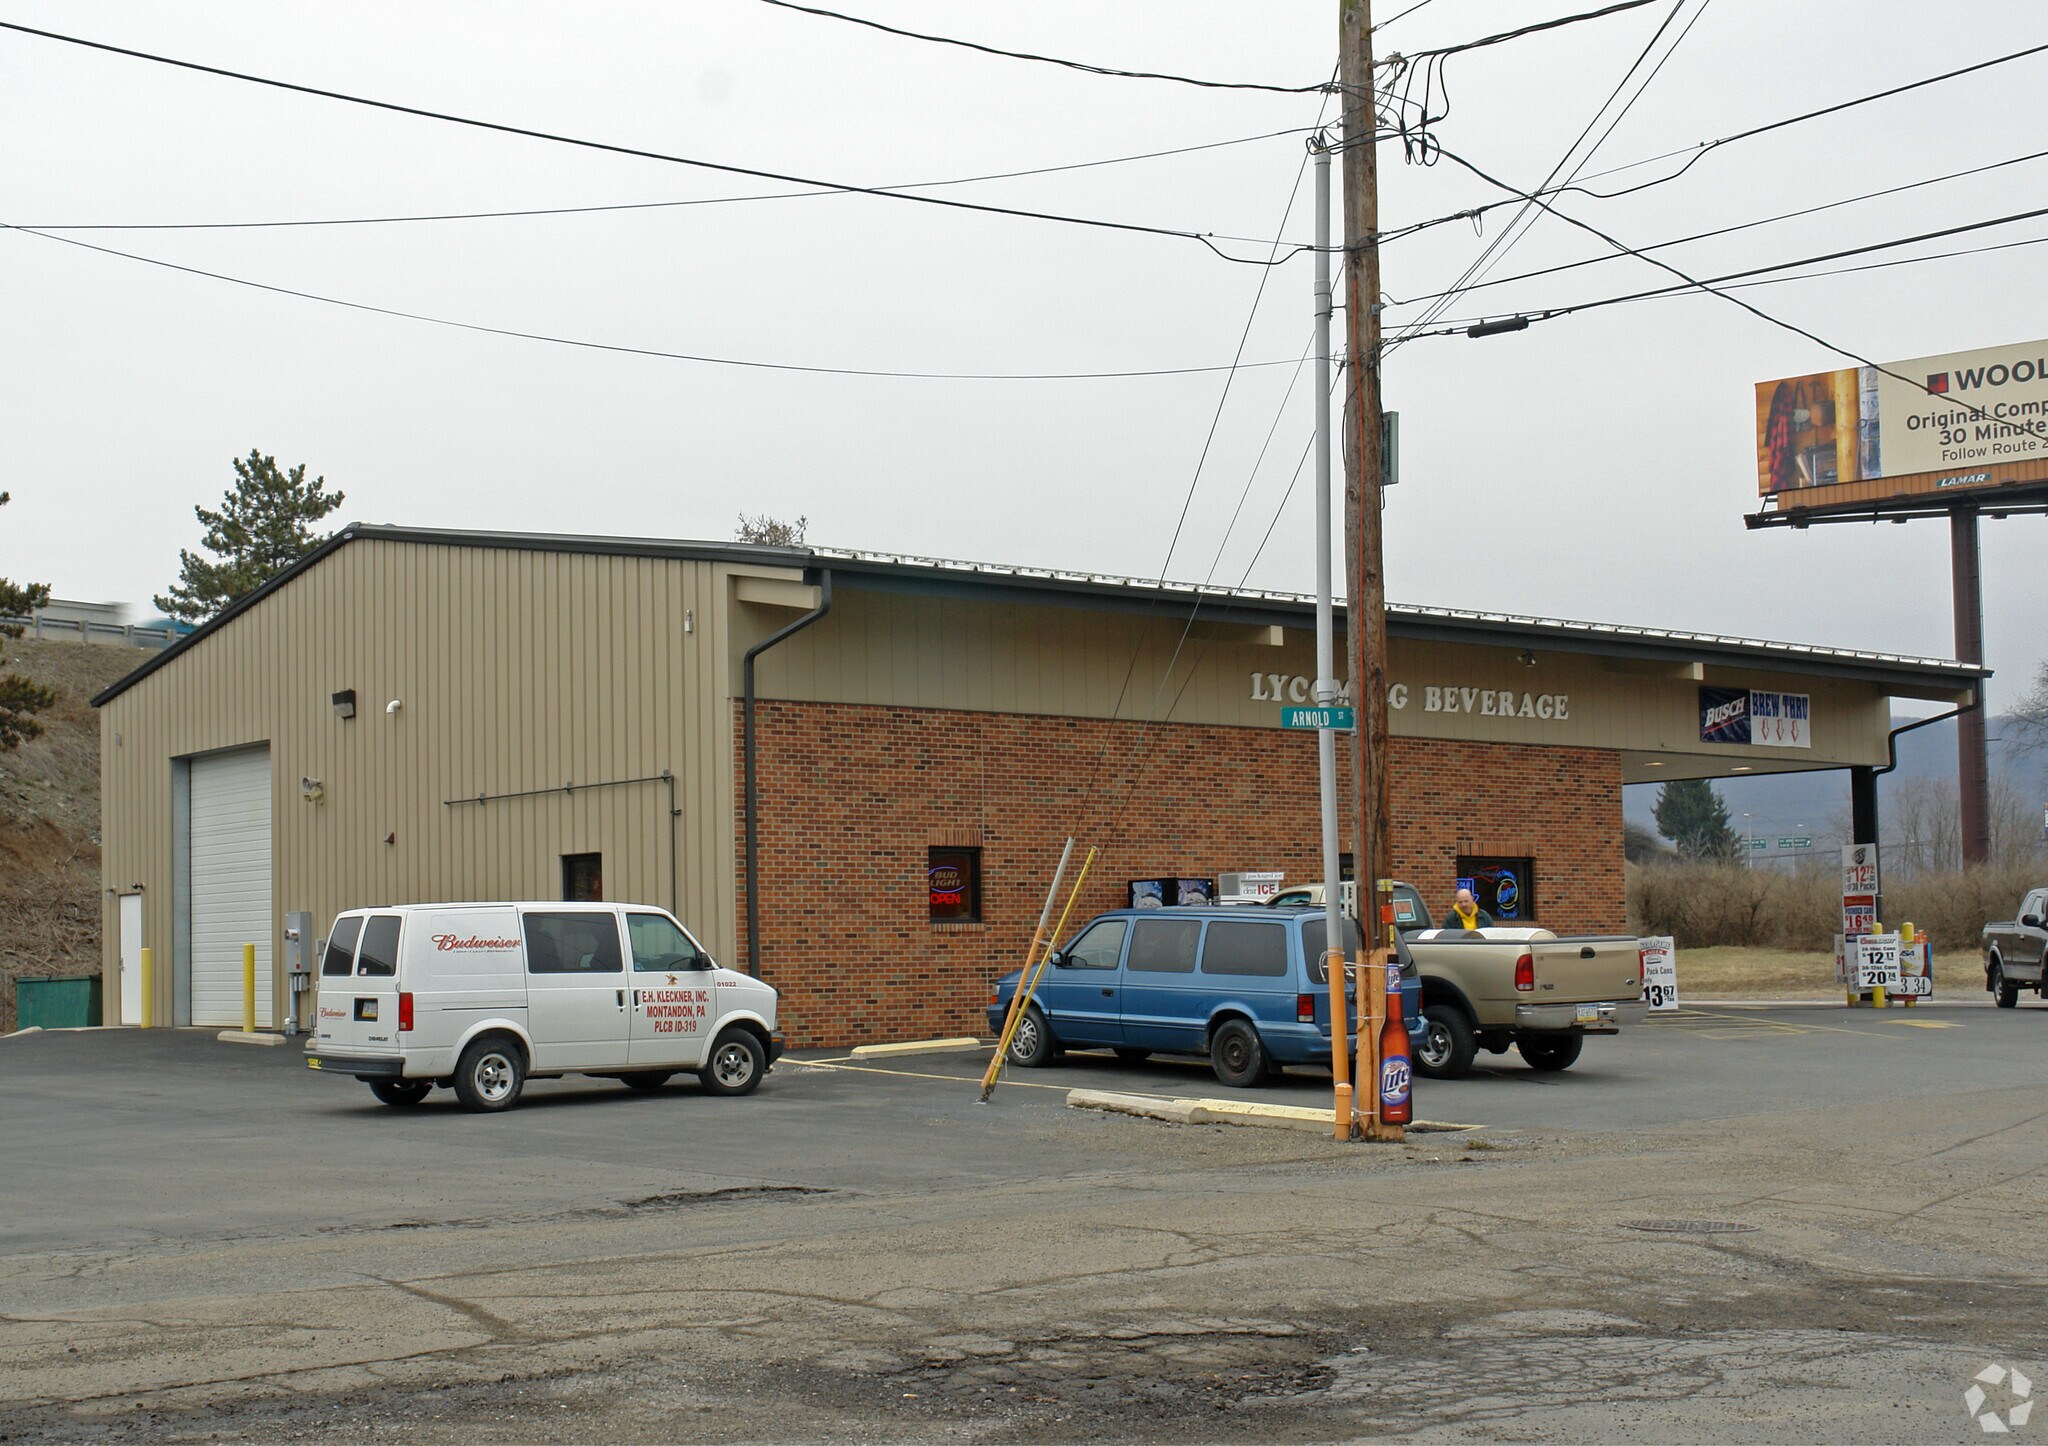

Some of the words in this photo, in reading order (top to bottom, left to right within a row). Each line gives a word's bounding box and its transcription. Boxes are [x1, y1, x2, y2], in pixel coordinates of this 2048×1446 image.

[1906, 405, 1986, 431] Original
[1939, 428, 1967, 446] 30
[1975, 418, 2047, 441] Minute
[1942, 447, 1987, 461] Follow
[1992, 439, 2037, 455] Route
[1941, 473, 1986, 487] LAMAR
[1424, 686, 1569, 720] BEVERAGE
[1752, 692, 1780, 717] BREW
[1782, 694, 1808, 720] THRU
[1291, 711, 1330, 726] ARNOLD
[1338, 711, 1344, 720] ST
[1704, 697, 1746, 727] BUSCH
[934, 871, 958, 879] BUD
[930, 879, 960, 887] LIGHT
[1257, 883, 1276, 895] ICE
[930, 893, 961, 904] OPEN
[431, 934, 521, 951] Budweiser
[642, 991, 656, 1002] E.H.
[656, 990, 695, 1004] KLECKNER,
[695, 990, 709, 1002] INC.
[646, 1006, 695, 1019] MONTANDON,
[696, 1006, 706, 1017] PA
[654, 1021, 673, 1033] PLCB
[674, 1020, 697, 1032] ID-319
[1383, 1067, 1409, 1094] Lite
